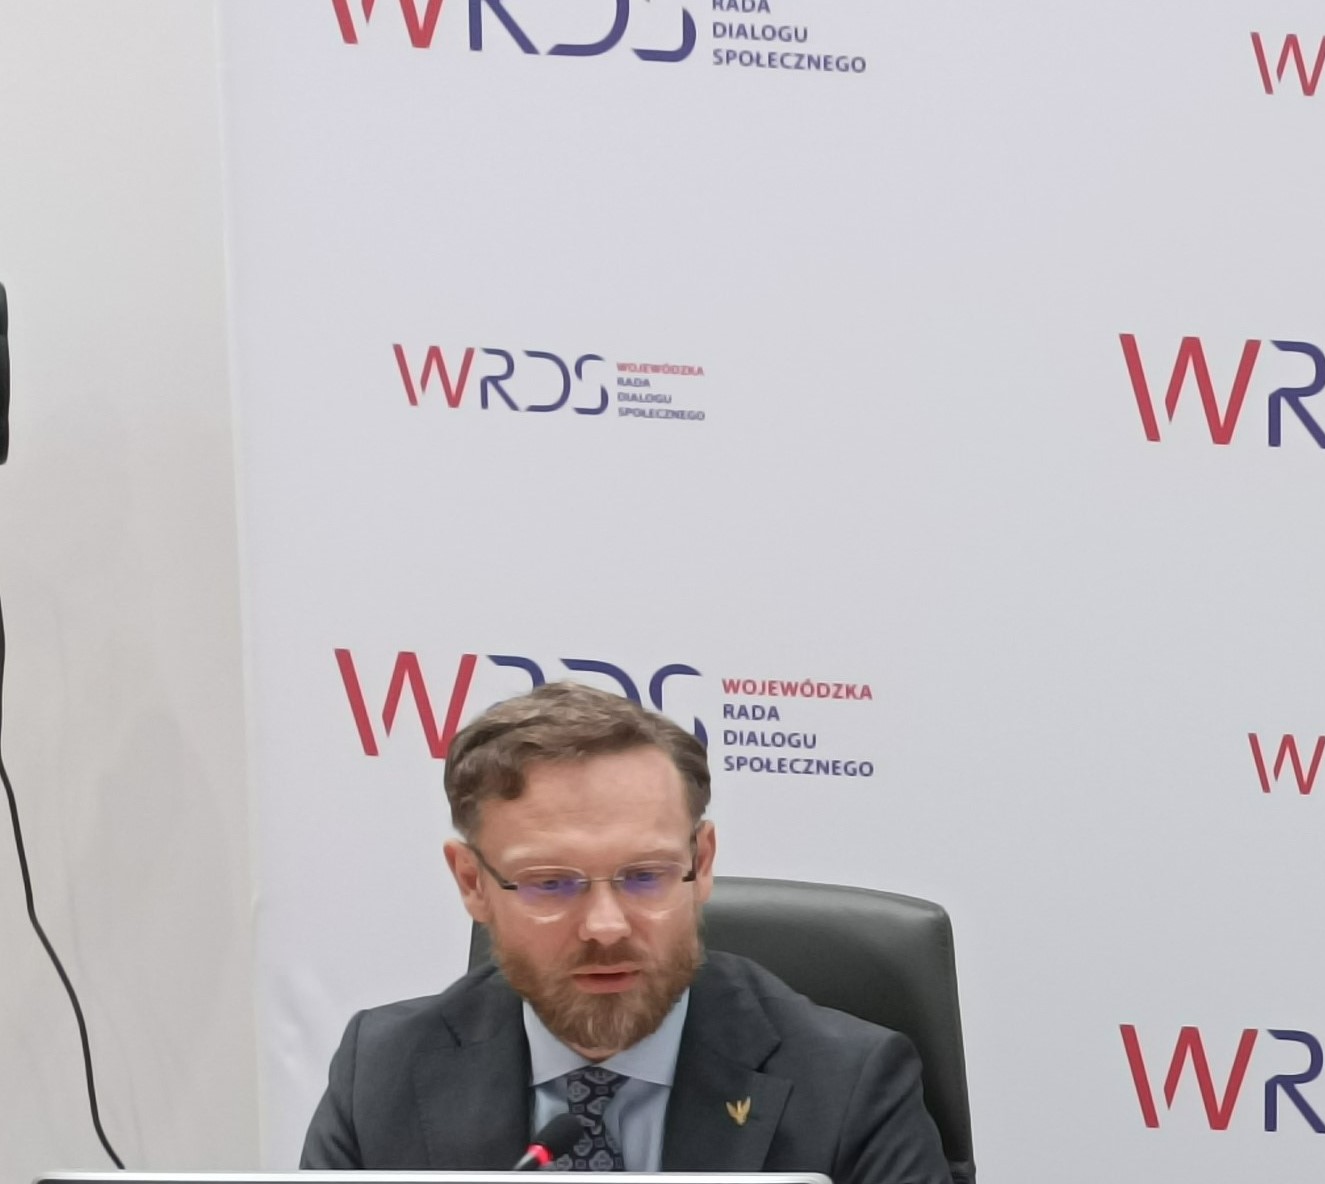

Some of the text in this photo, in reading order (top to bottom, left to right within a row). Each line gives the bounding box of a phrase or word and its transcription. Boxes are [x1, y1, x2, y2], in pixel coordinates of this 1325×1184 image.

[713, 0, 770, 13] RADA
[713, 22, 807, 43] DIALOGU
[713, 49, 866, 73] SPOŁECZNEGO
[393, 344, 608, 415] WRDS
[722, 679, 872, 700] WOJEWÓDZKA
[724, 704, 779, 721] RADA
[724, 730, 816, 749] DIALOGU
[724, 756, 873, 777] SPOŁECZNEGO
